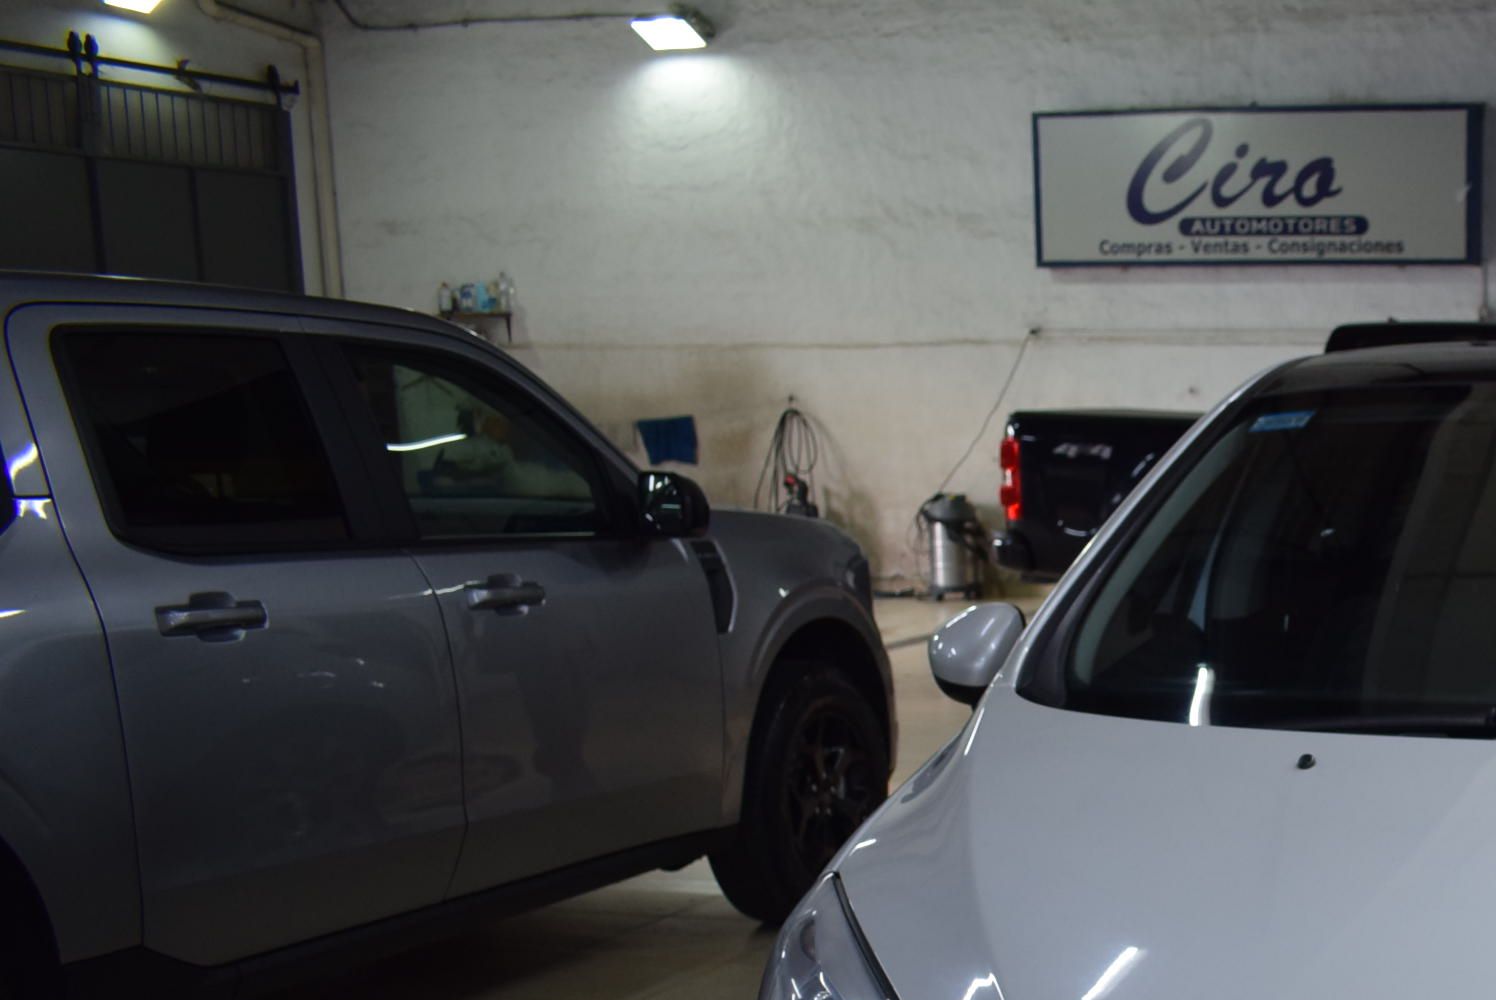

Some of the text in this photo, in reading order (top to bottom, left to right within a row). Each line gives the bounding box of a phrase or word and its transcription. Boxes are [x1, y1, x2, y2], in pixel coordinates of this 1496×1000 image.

[1127, 117, 1343, 225] Ciro
[1190, 217, 1357, 234] AUTOMOTORES
[1099, 238, 1173, 256] Compras
[1190, 237, 1250, 254] Ventas
[1267, 237, 1404, 256] Consignaciones
